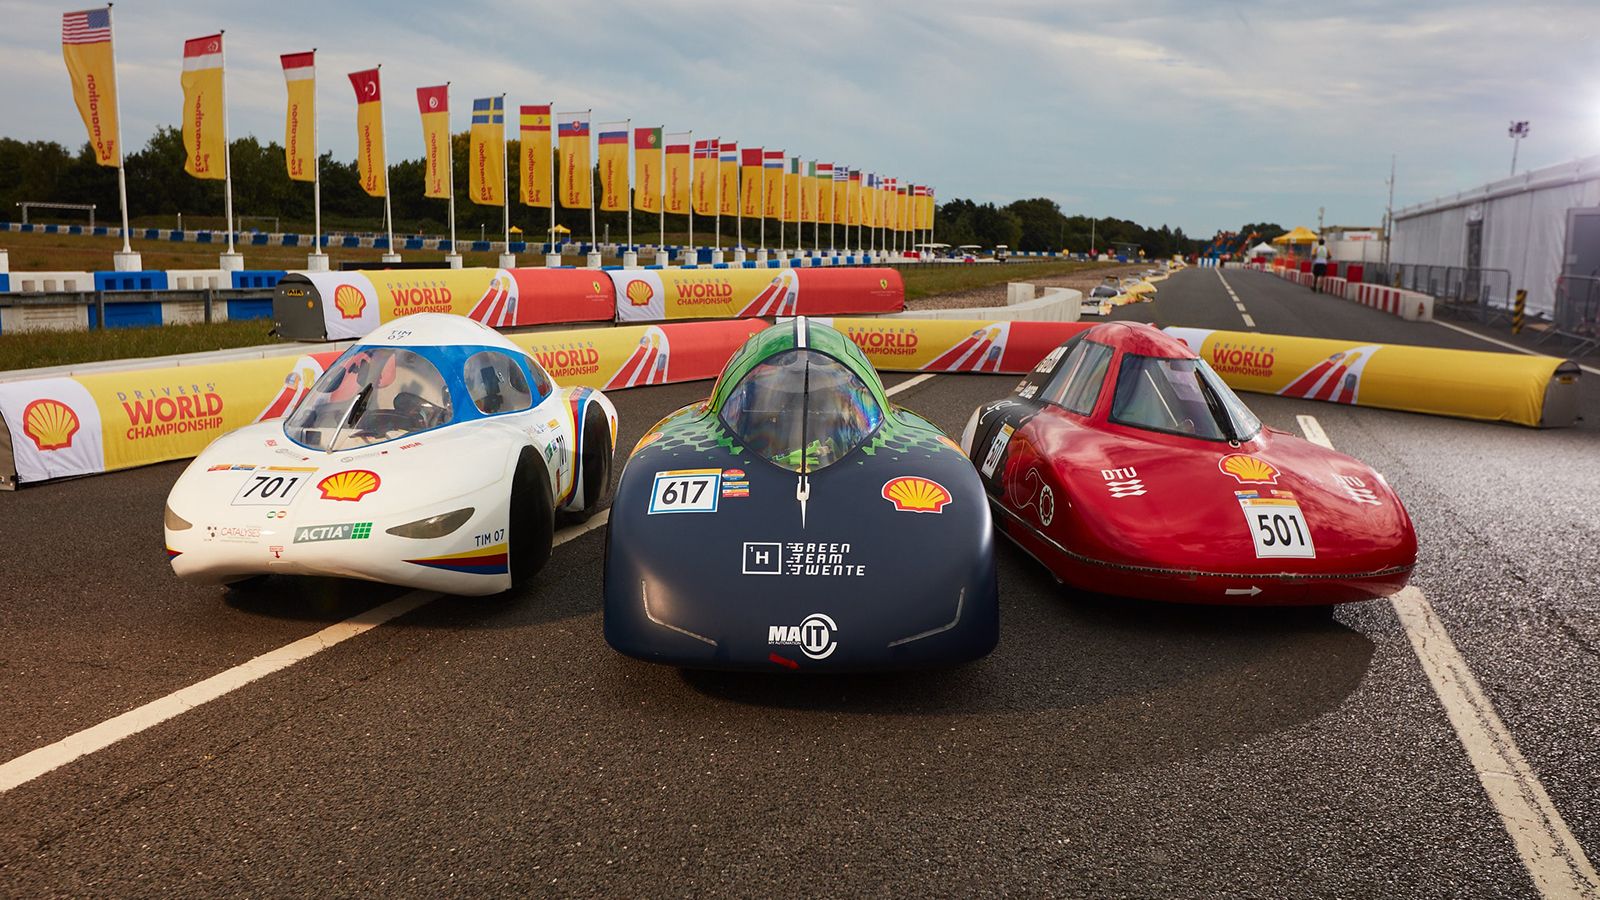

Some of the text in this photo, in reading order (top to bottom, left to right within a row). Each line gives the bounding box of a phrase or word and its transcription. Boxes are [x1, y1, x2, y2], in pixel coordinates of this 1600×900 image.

[391, 287, 452, 306] WORLD
[676, 283, 733, 298] WORLD
[677, 297, 733, 305] CHAMPIONSHIP
[393, 305, 453, 316] CHAMPIONSHIP
[849, 332, 919, 348] WORLD
[535, 348, 599, 369] WORLD
[862, 347, 917, 355] AMPIONSHIP
[1212, 348, 1274, 369] WORLD
[122, 393, 223, 426] WORLD
[127, 417, 223, 440] CHAMPIONSHIP
[1101, 467, 1137, 481] DTU
[243, 476, 299, 498] 701
[662, 481, 709, 505] 617
[298, 526, 344, 541] ACTIA
[475, 529, 505, 547] TIM 07
[1257, 514, 1305, 547] 501
[791, 543, 850, 553] GREEN
[755, 551, 769, 565] H
[791, 554, 842, 563] TEAM
[790, 565, 865, 576] TWENTE
